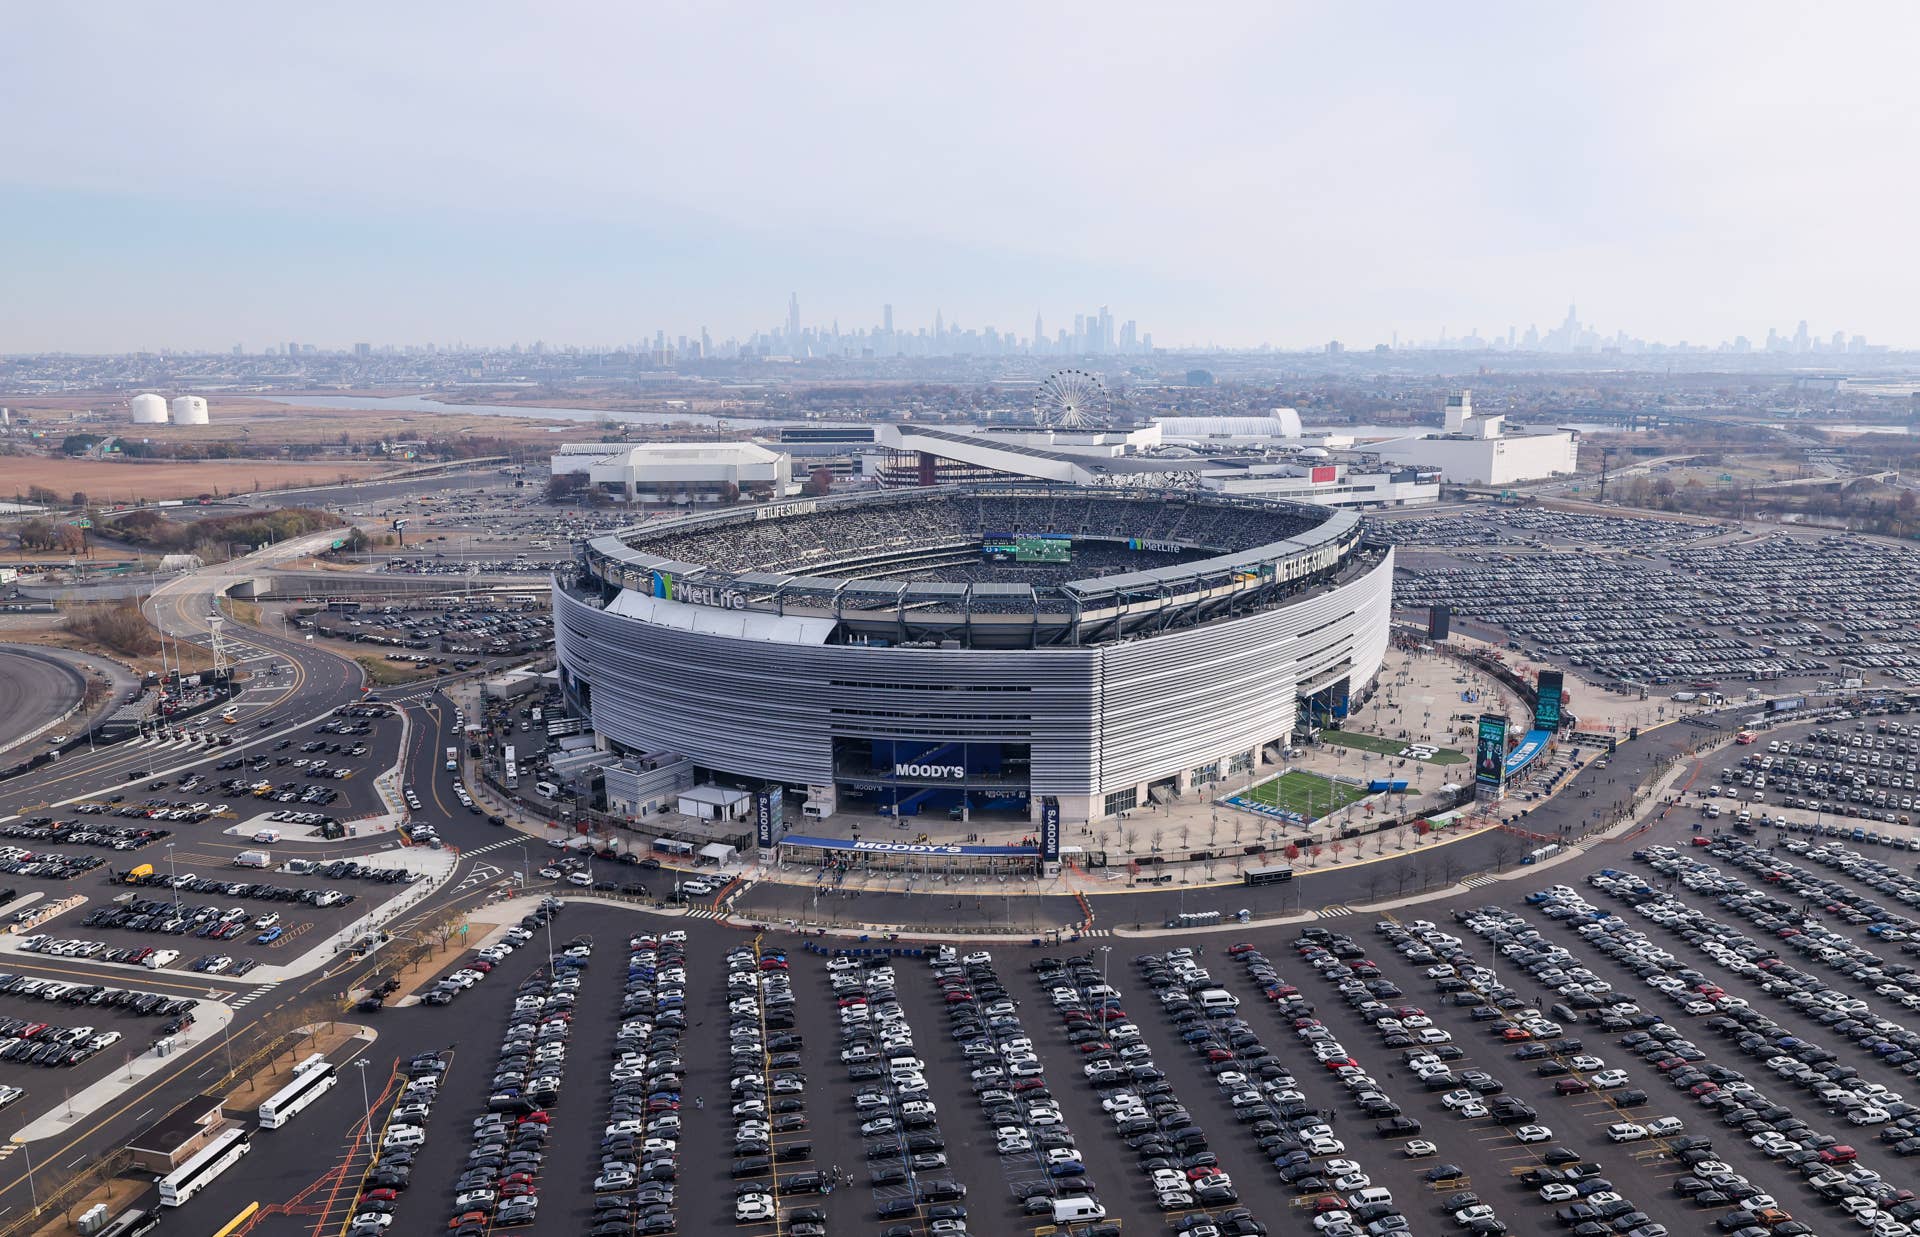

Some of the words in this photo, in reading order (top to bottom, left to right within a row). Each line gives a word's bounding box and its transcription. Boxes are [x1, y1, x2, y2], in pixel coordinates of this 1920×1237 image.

[756, 505, 785, 520] METLIFE
[786, 501, 817, 516] STADIUM
[1142, 540, 1180, 553] MetLife
[1275, 554, 1311, 585] METLIFE
[1311, 543, 1340, 572] STADIUM
[678, 583, 745, 609] MetLife
[895, 763, 964, 778] MOODY'S
[759, 797, 769, 841] MOODY'S
[1047, 809, 1057, 854] MOODY'S
[853, 841, 963, 853] MOODY'S
